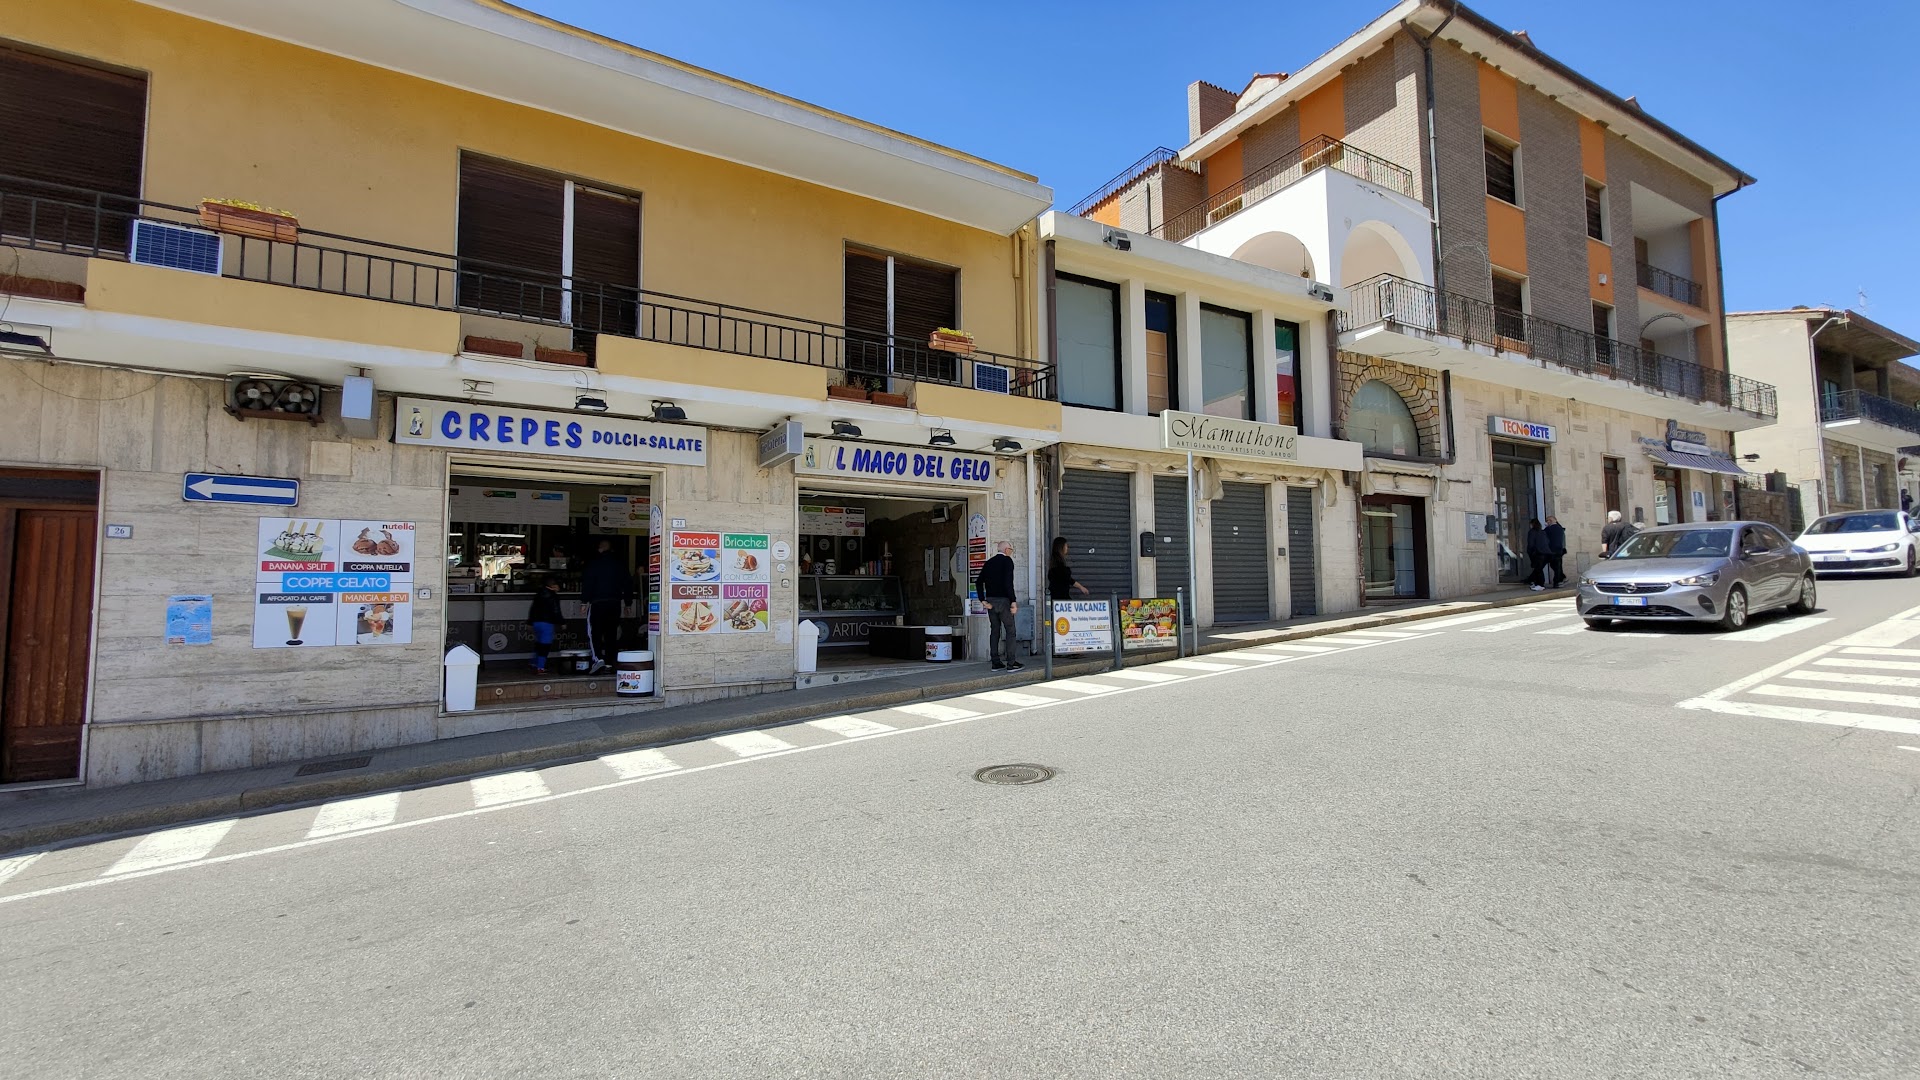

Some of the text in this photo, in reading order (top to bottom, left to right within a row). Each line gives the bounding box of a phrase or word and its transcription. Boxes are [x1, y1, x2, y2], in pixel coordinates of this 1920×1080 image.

[441, 410, 583, 449] CREPES
[1171, 416, 1294, 450] Mamuthone
[1502, 420, 1549, 439] TECNORETE
[760, 432, 787, 455] Gelateria
[1176, 441, 1225, 451] ARTIGIANATO
[1230, 445, 1266, 455] ARTISTICO
[852, 448, 907, 476] MAGO
[913, 454, 945, 479] DEL
[950, 457, 991, 482] GELO
[382, 523, 415, 531] nutella
[673, 535, 718, 546] Pancake
[724, 536, 767, 548] Brioches
[269, 563, 328, 571] BANANA SPLIT
[286, 577, 388, 588] COPPE GELATO
[678, 586, 713, 596] CREPES
[728, 586, 765, 598] Waffel
[1054, 602, 1107, 612] CASE VACANZE
[484, 621, 516, 632] Frutta
